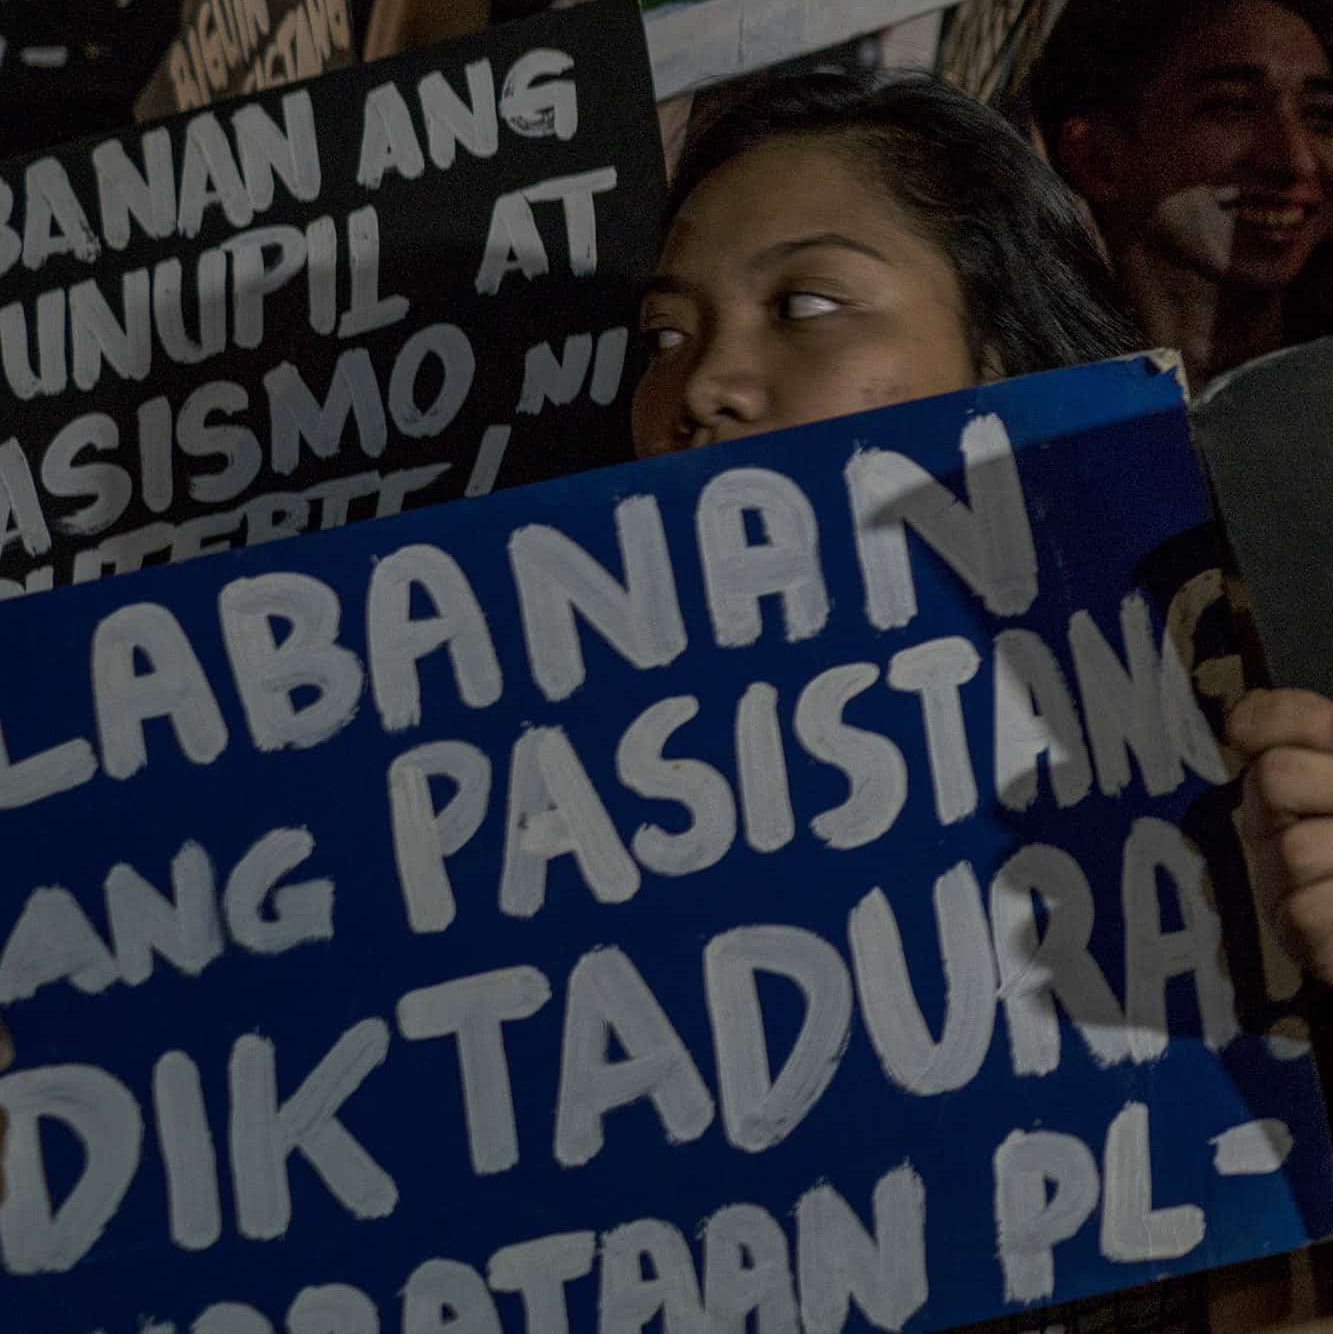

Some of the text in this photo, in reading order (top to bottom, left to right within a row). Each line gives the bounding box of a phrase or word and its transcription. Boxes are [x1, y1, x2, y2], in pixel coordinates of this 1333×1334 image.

[356, 46, 578, 190] ANG
[474, 166, 618, 296] AT
[0, 824, 336, 1006] ANG
